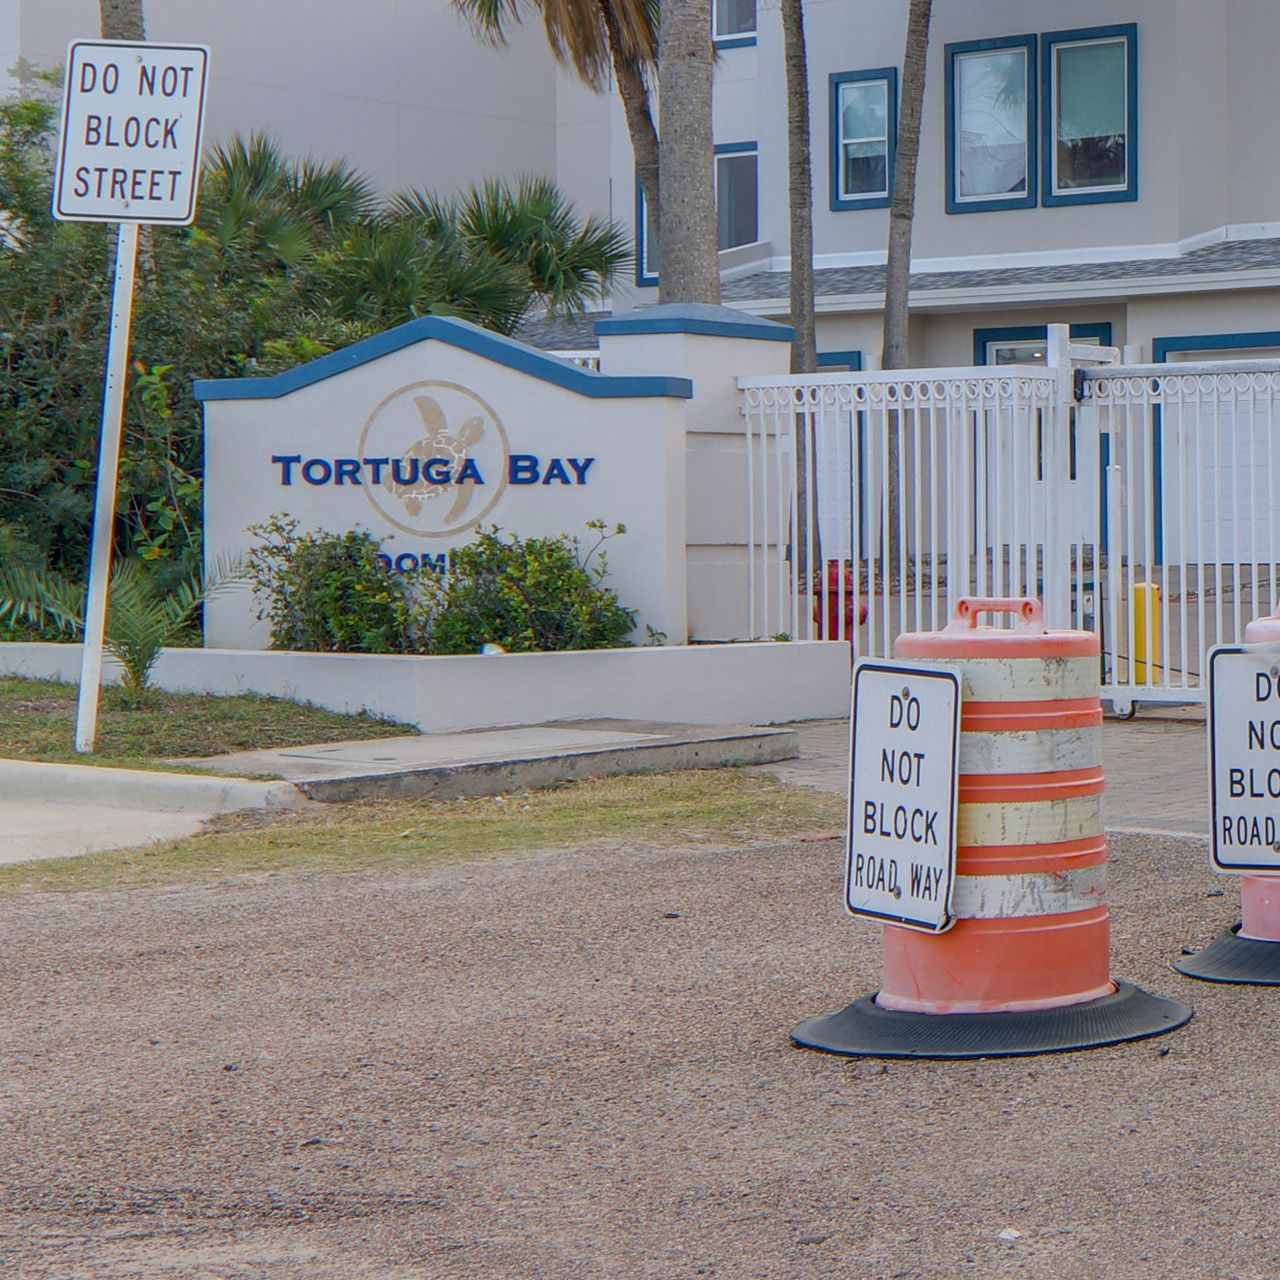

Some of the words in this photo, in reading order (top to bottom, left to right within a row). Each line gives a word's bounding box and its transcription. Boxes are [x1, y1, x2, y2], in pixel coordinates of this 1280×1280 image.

[79, 63, 120, 95] DO
[138, 65, 194, 98] NOT
[85, 115, 178, 148] BLOCK
[74, 167, 182, 202] STREET
[272, 454, 484, 487] TORTUGA
[507, 454, 596, 487] BAY
[889, 694, 921, 732] DO
[881, 750, 924, 788] NOT
[863, 801, 938, 846] BLOCK
[854, 853, 901, 896] ROAD
[906, 861, 943, 903] WAY
